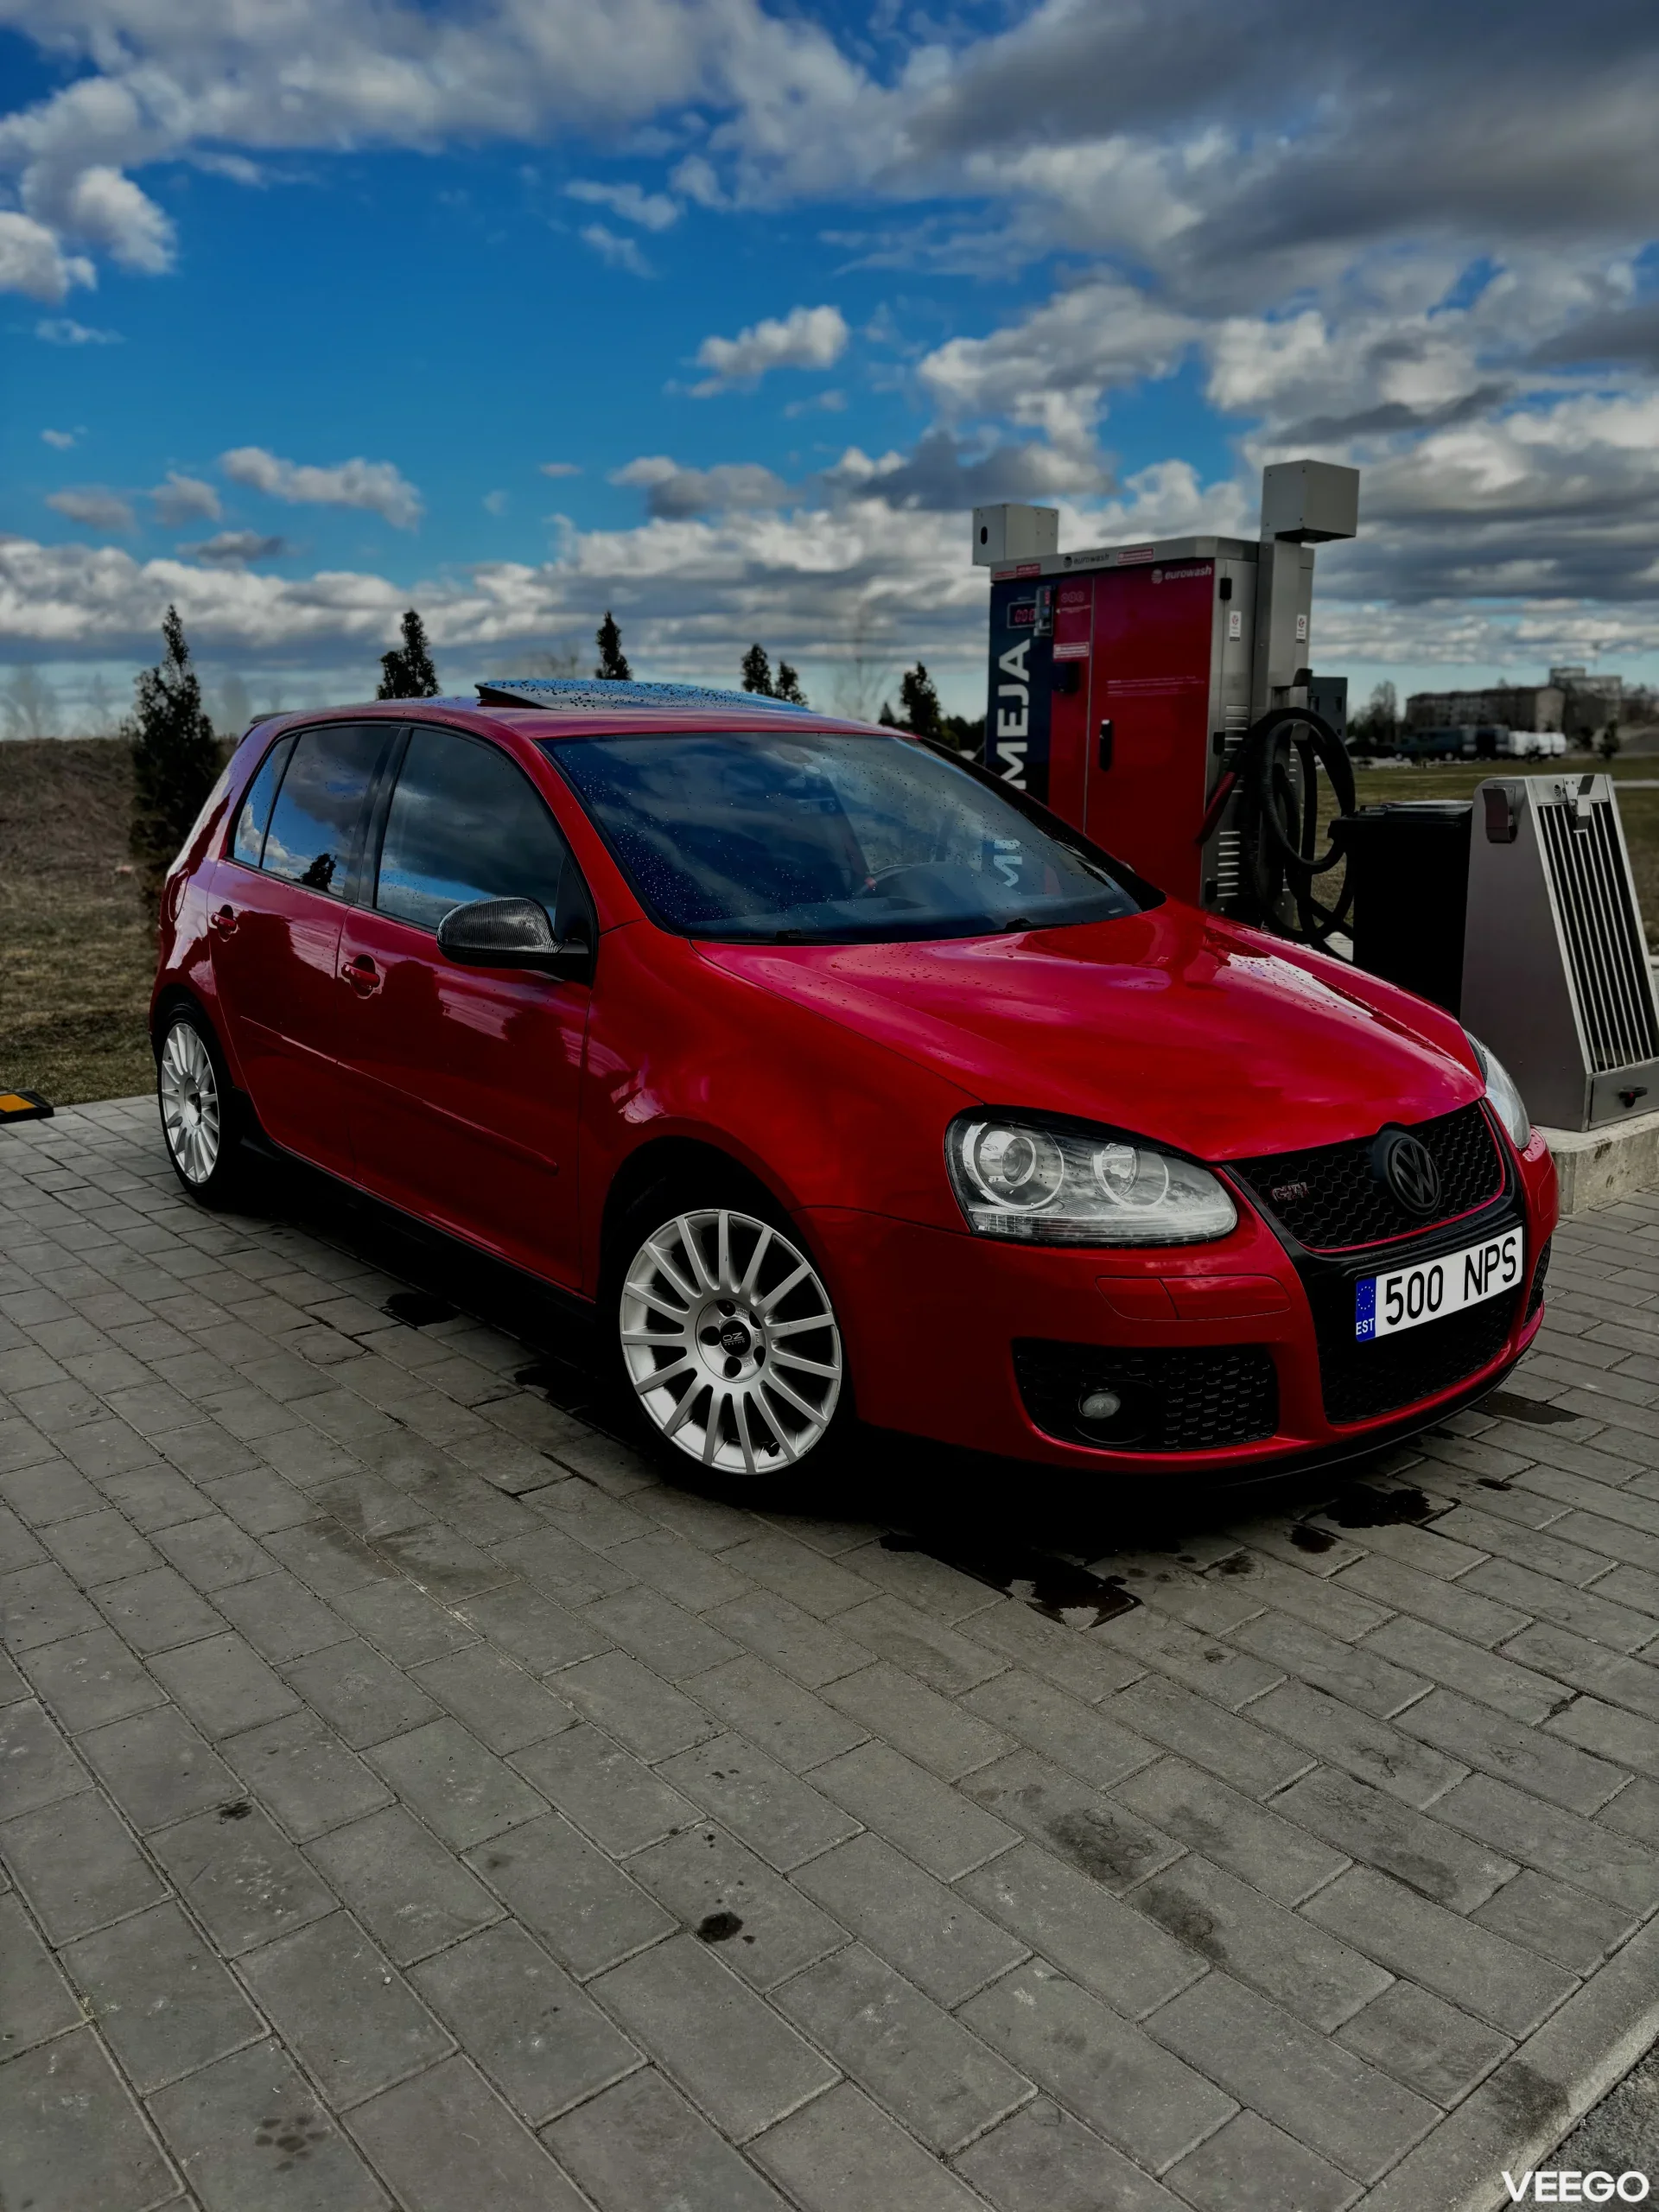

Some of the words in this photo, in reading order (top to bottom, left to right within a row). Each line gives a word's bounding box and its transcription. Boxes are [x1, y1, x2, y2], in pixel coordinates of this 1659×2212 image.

[1165, 564, 1212, 581] eurowash
[1355, 1317, 1375, 1336] EST
[1384, 1264, 1445, 1326] 500
[1464, 1236, 1517, 1301] NPS
